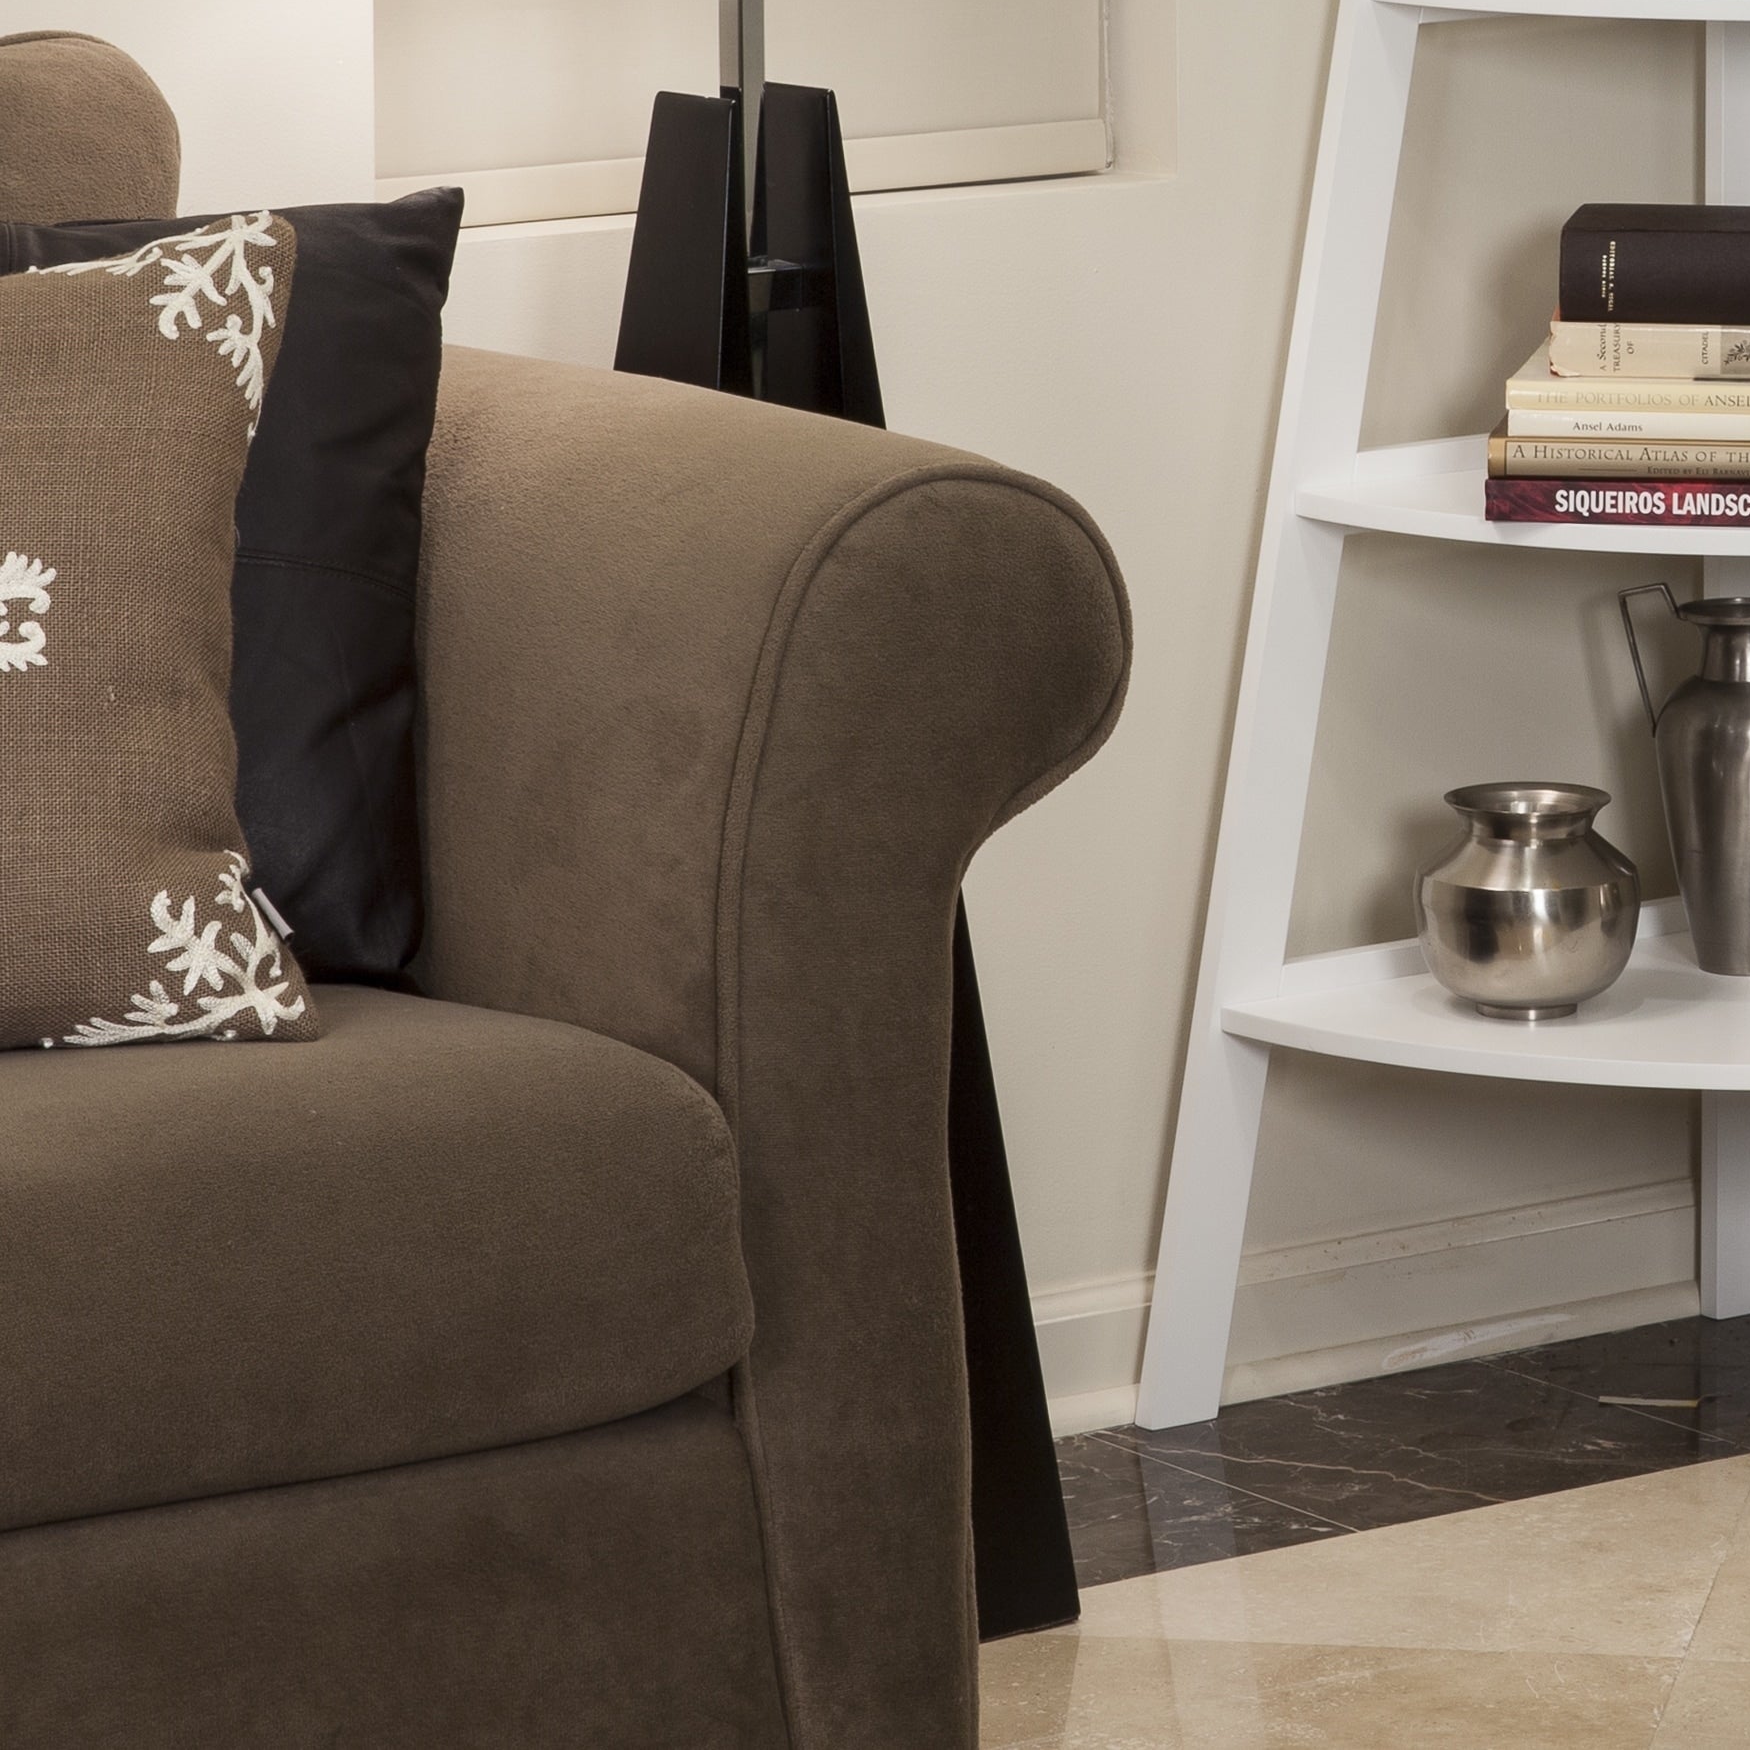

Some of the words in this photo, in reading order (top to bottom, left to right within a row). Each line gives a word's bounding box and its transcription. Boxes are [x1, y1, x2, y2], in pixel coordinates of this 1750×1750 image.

[1612, 323, 1621, 372] TREASURY
[1627, 340, 1635, 355] OF
[1701, 331, 1709, 365] CITADEL
[1576, 392, 1672, 407] PORTFOLIOS
[1679, 394, 1699, 406] OF
[1572, 421, 1602, 432] Ansel
[1606, 422, 1643, 433] Adams
[1512, 444, 1525, 459] A
[1534, 445, 1633, 461] HISTORICAL
[1639, 447, 1688, 462] ATLAS
[1695, 450, 1717, 463] OF
[1554, 489, 1666, 517] SIQUEIROS
